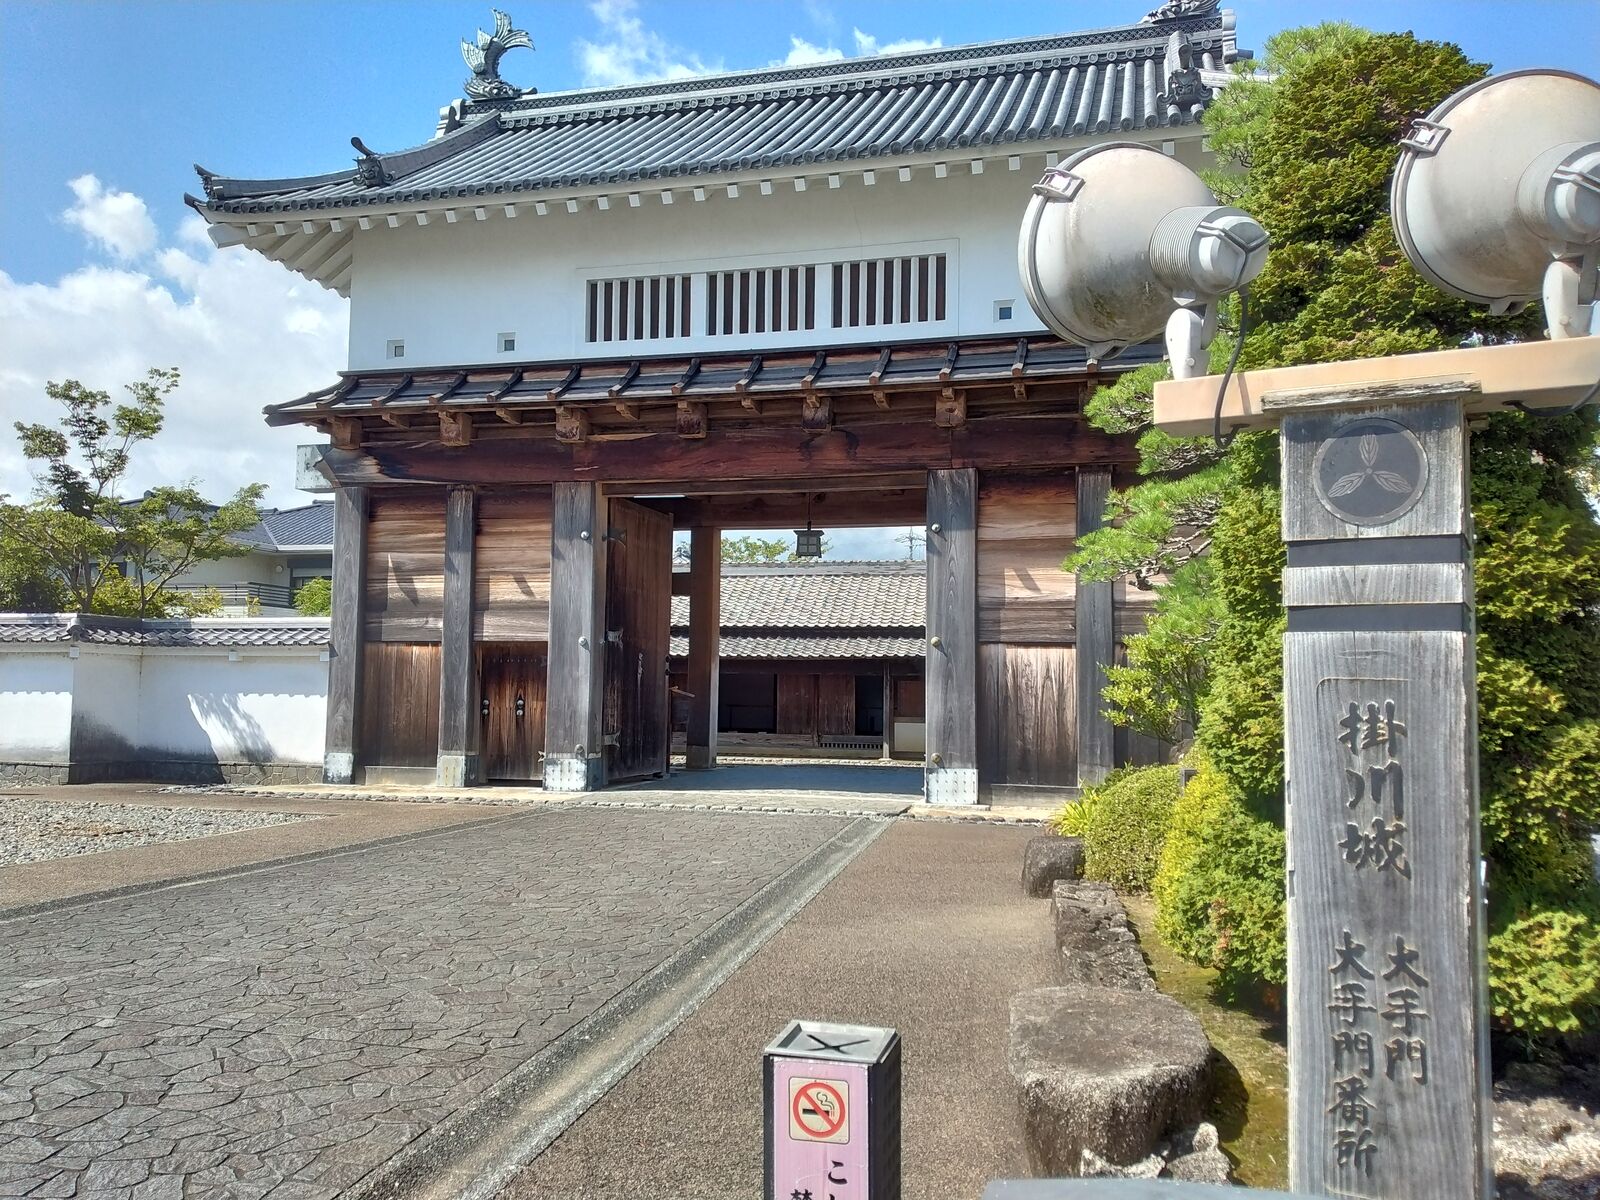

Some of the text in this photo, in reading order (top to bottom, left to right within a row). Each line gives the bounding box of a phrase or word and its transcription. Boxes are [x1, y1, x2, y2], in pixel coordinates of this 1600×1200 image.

[1338, 699, 1411, 880] 掛川城
[1327, 930, 1377, 1177] 大手門番所
[1381, 935, 1429, 1085] 大手門
[828, 1160, 848, 1200] こ
